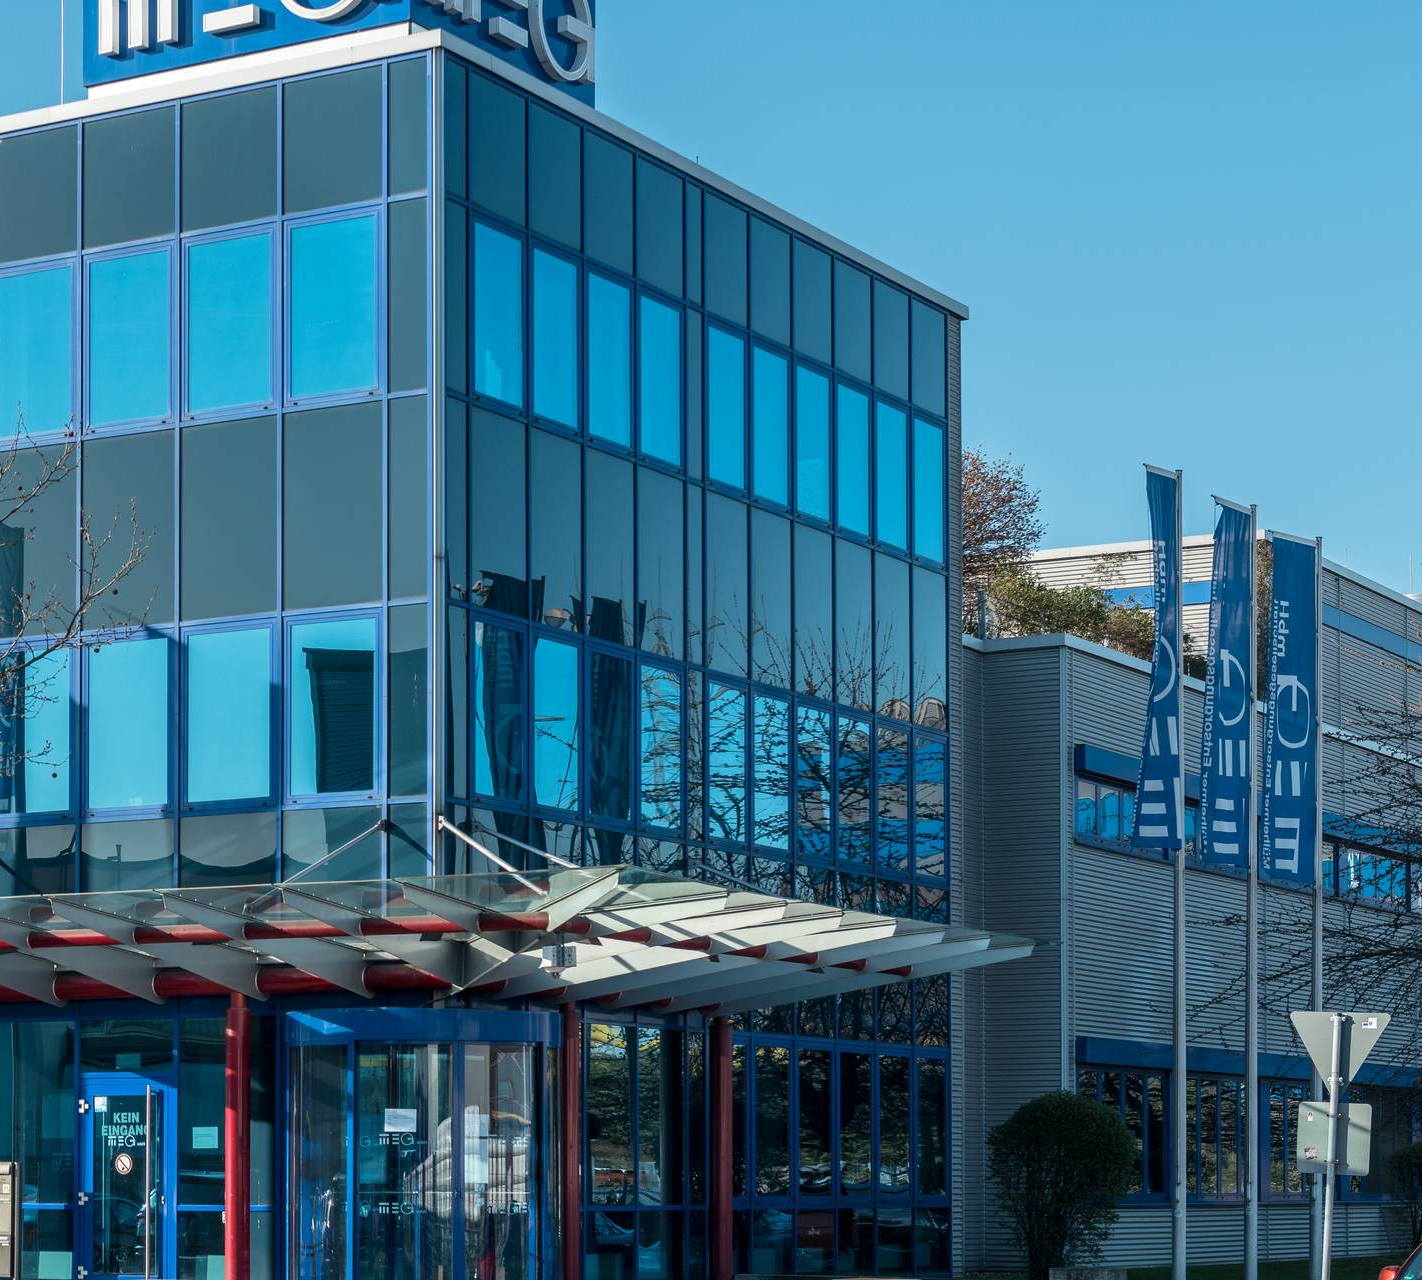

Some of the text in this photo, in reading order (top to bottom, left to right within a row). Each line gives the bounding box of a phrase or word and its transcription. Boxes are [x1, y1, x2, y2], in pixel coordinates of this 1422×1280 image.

[113, 1112, 140, 1124] KEIN
[108, 1135, 136, 1148] MEG
[379, 1132, 415, 1146] MEG
[379, 1201, 415, 1215] MEG
